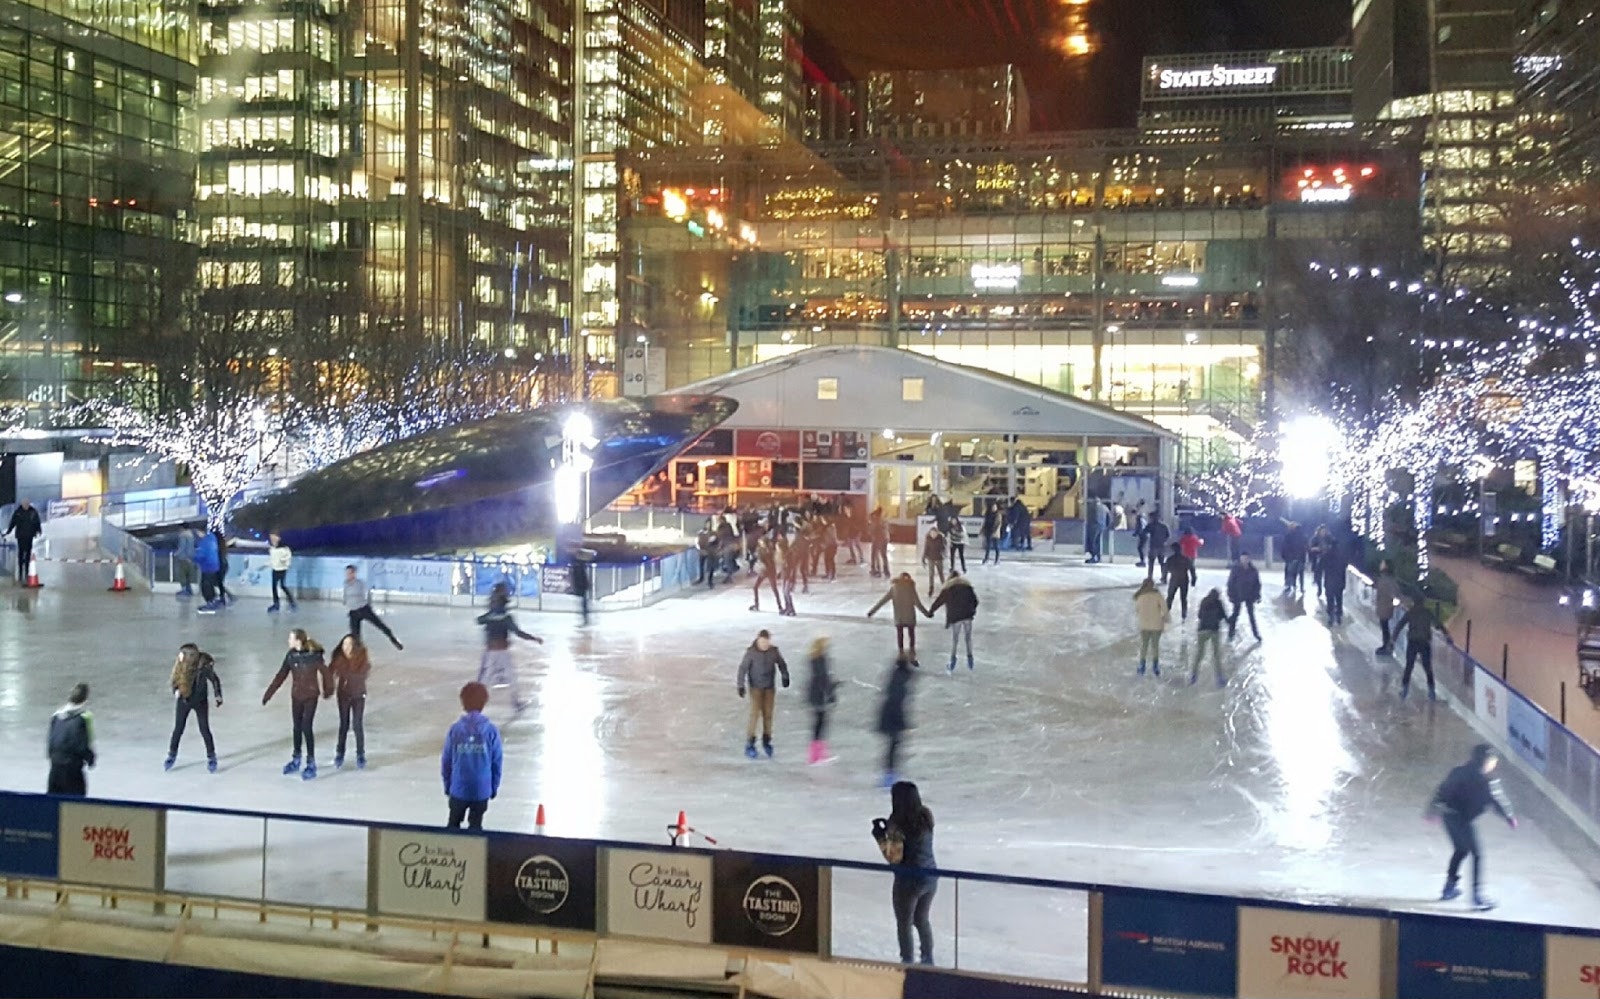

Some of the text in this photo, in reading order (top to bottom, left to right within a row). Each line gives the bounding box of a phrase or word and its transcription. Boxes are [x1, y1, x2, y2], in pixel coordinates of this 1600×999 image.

[1160, 64, 1276, 88] STATE STREET
[83, 826, 129, 844] SNOW
[93, 842, 135, 861] ROCK
[399, 843, 467, 881] Canary
[535, 868, 551, 877] THE
[629, 862, 703, 902] Canary
[404, 866, 464, 906] Wharf
[520, 876, 567, 892] TASTING
[530, 892, 555, 900] ROOM
[764, 889, 782, 899] THE
[634, 888, 699, 928] Wharf
[748, 897, 798, 914] TASTING
[759, 912, 786, 922] ROOM
[1270, 935, 1341, 958] SNOW
[1287, 956, 1348, 979] ROCK
